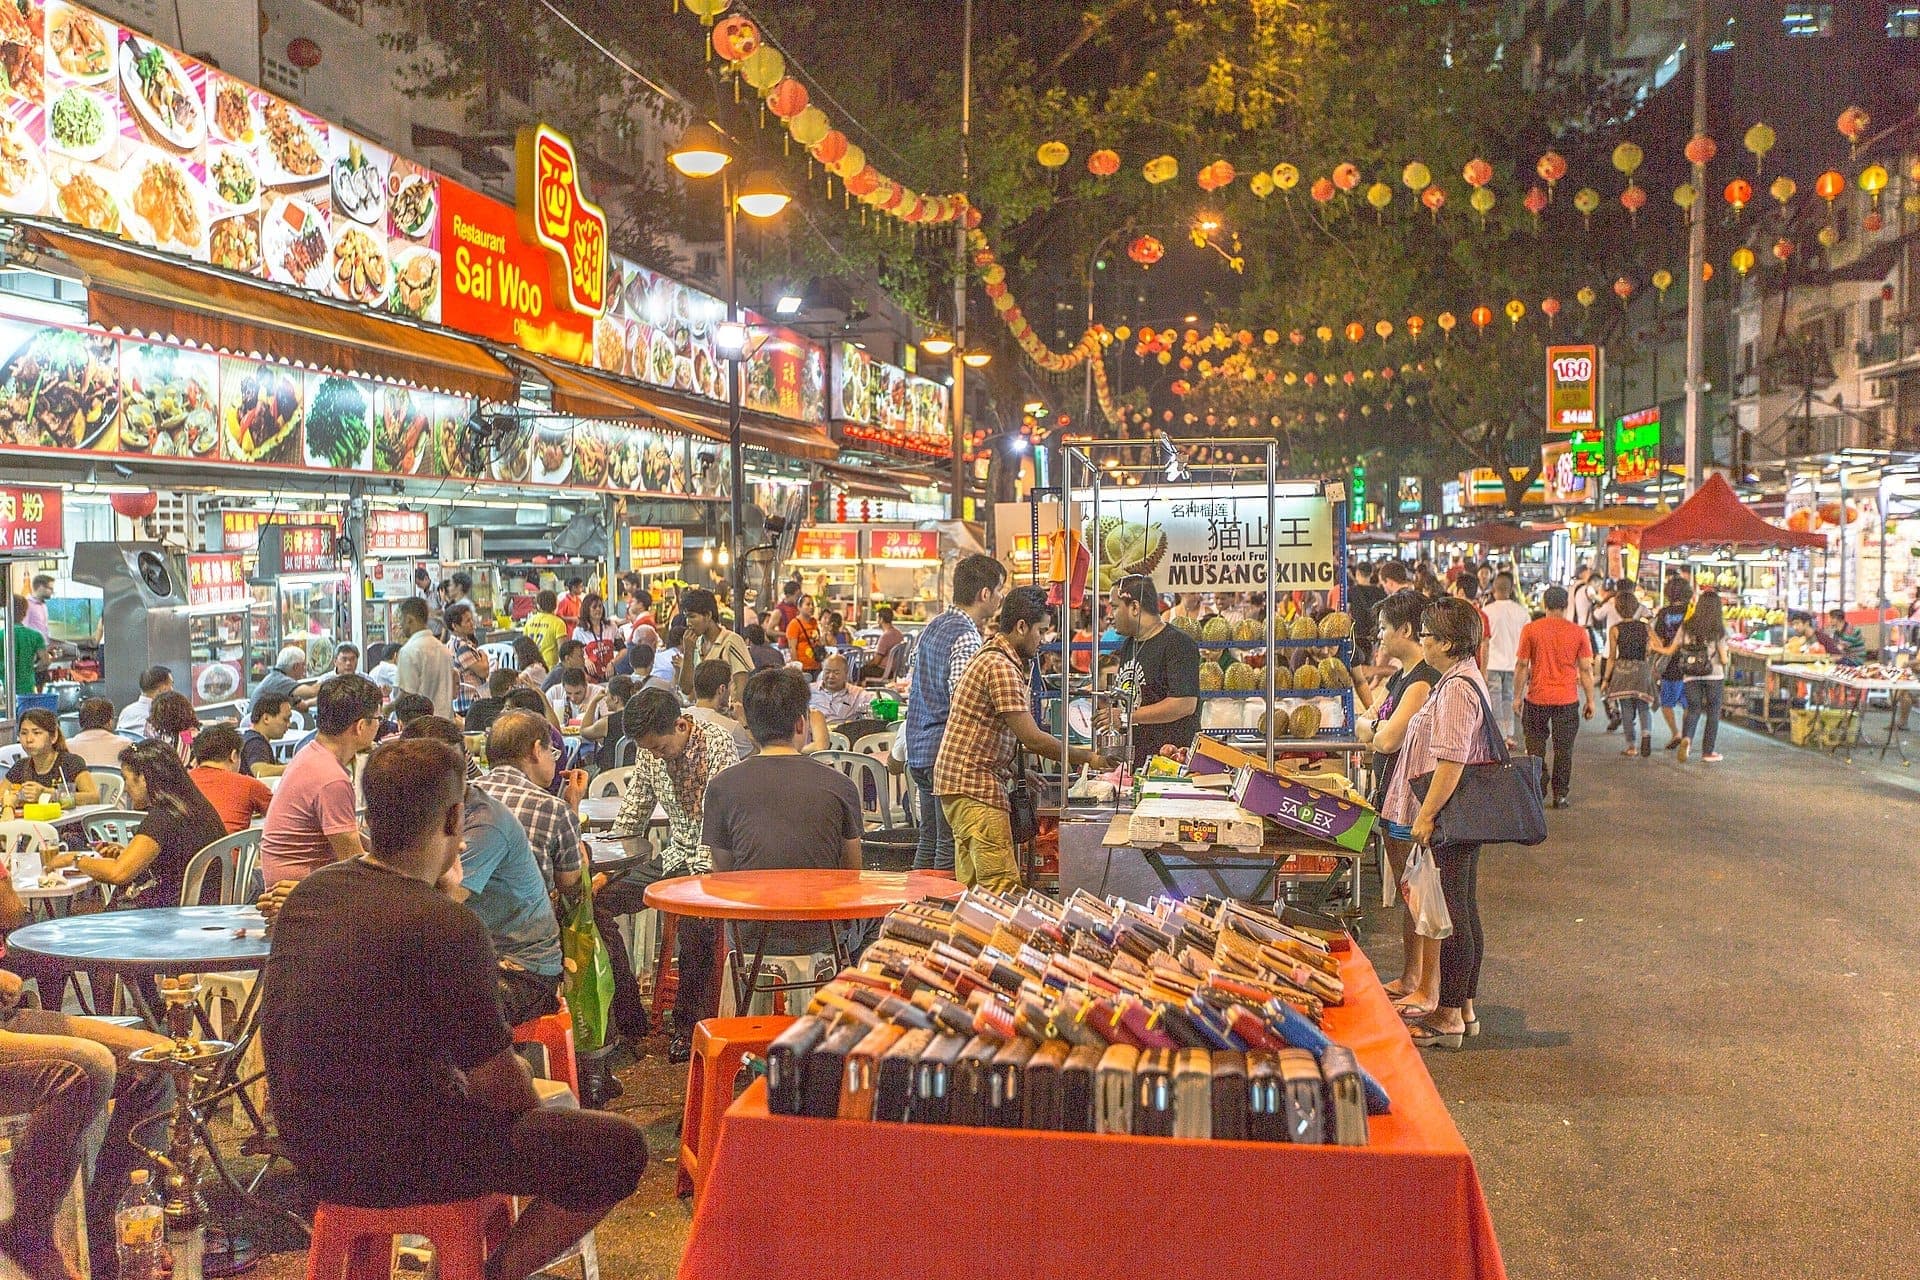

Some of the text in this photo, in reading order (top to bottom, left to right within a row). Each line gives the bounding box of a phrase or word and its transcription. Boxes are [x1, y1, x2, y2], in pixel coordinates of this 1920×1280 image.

[453, 214, 506, 254] Restaurant
[455, 246, 542, 317] Sai Woo
[1556, 360, 1590, 379] 168
[1171, 503, 1229, 518] 名种榴莲
[13, 528, 37, 546] MEE
[1207, 516, 1313, 551] 猫山王
[881, 545, 927, 559] SATAY
[1172, 551, 1268, 563] Malaysia Local Frui
[1168, 561, 1333, 585] MUSANG KING
[1279, 801, 1334, 829] SAPEX
